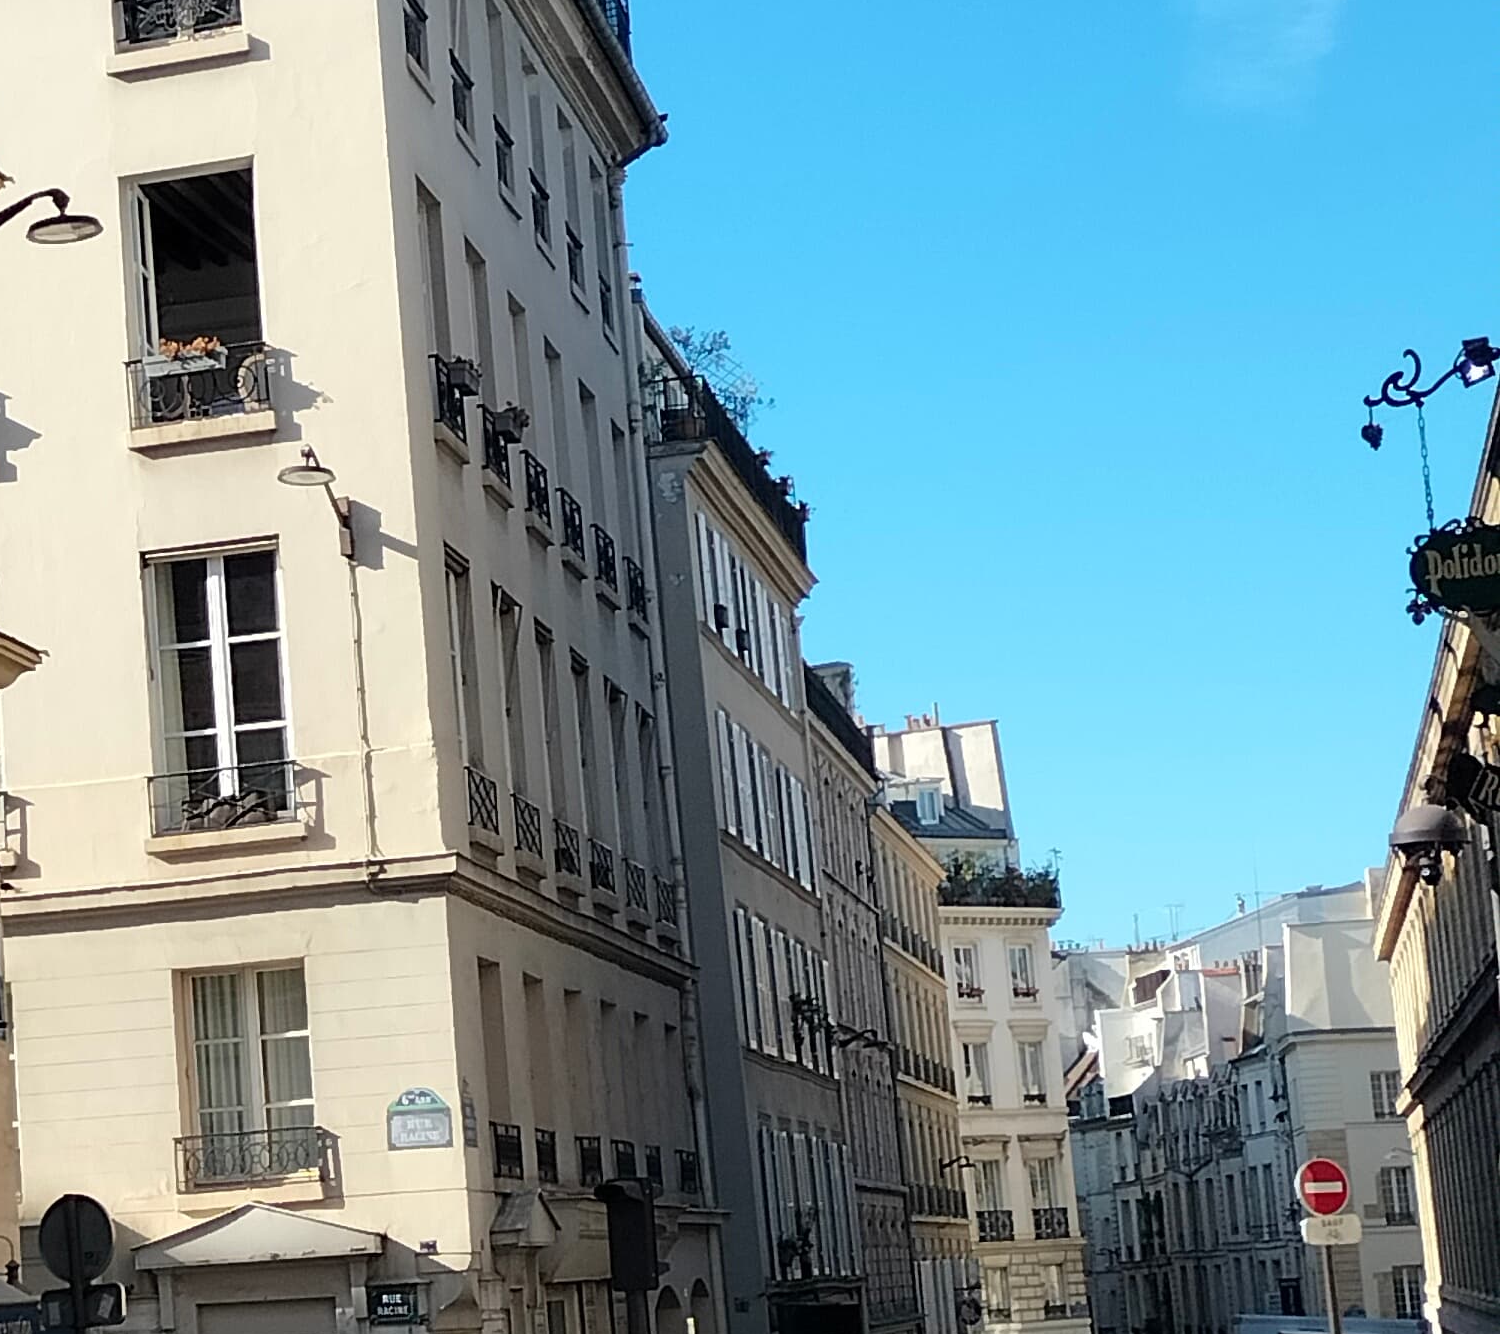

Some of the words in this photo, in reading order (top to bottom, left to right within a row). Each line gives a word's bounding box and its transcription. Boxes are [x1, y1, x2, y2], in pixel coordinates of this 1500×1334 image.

[1425, 542, 1500, 598] Polido
[406, 1118, 434, 1130] RUE
[399, 1130, 441, 1143] RACINE
[381, 1293, 402, 1304] RUE
[376, 1305, 409, 1316] RACINE
